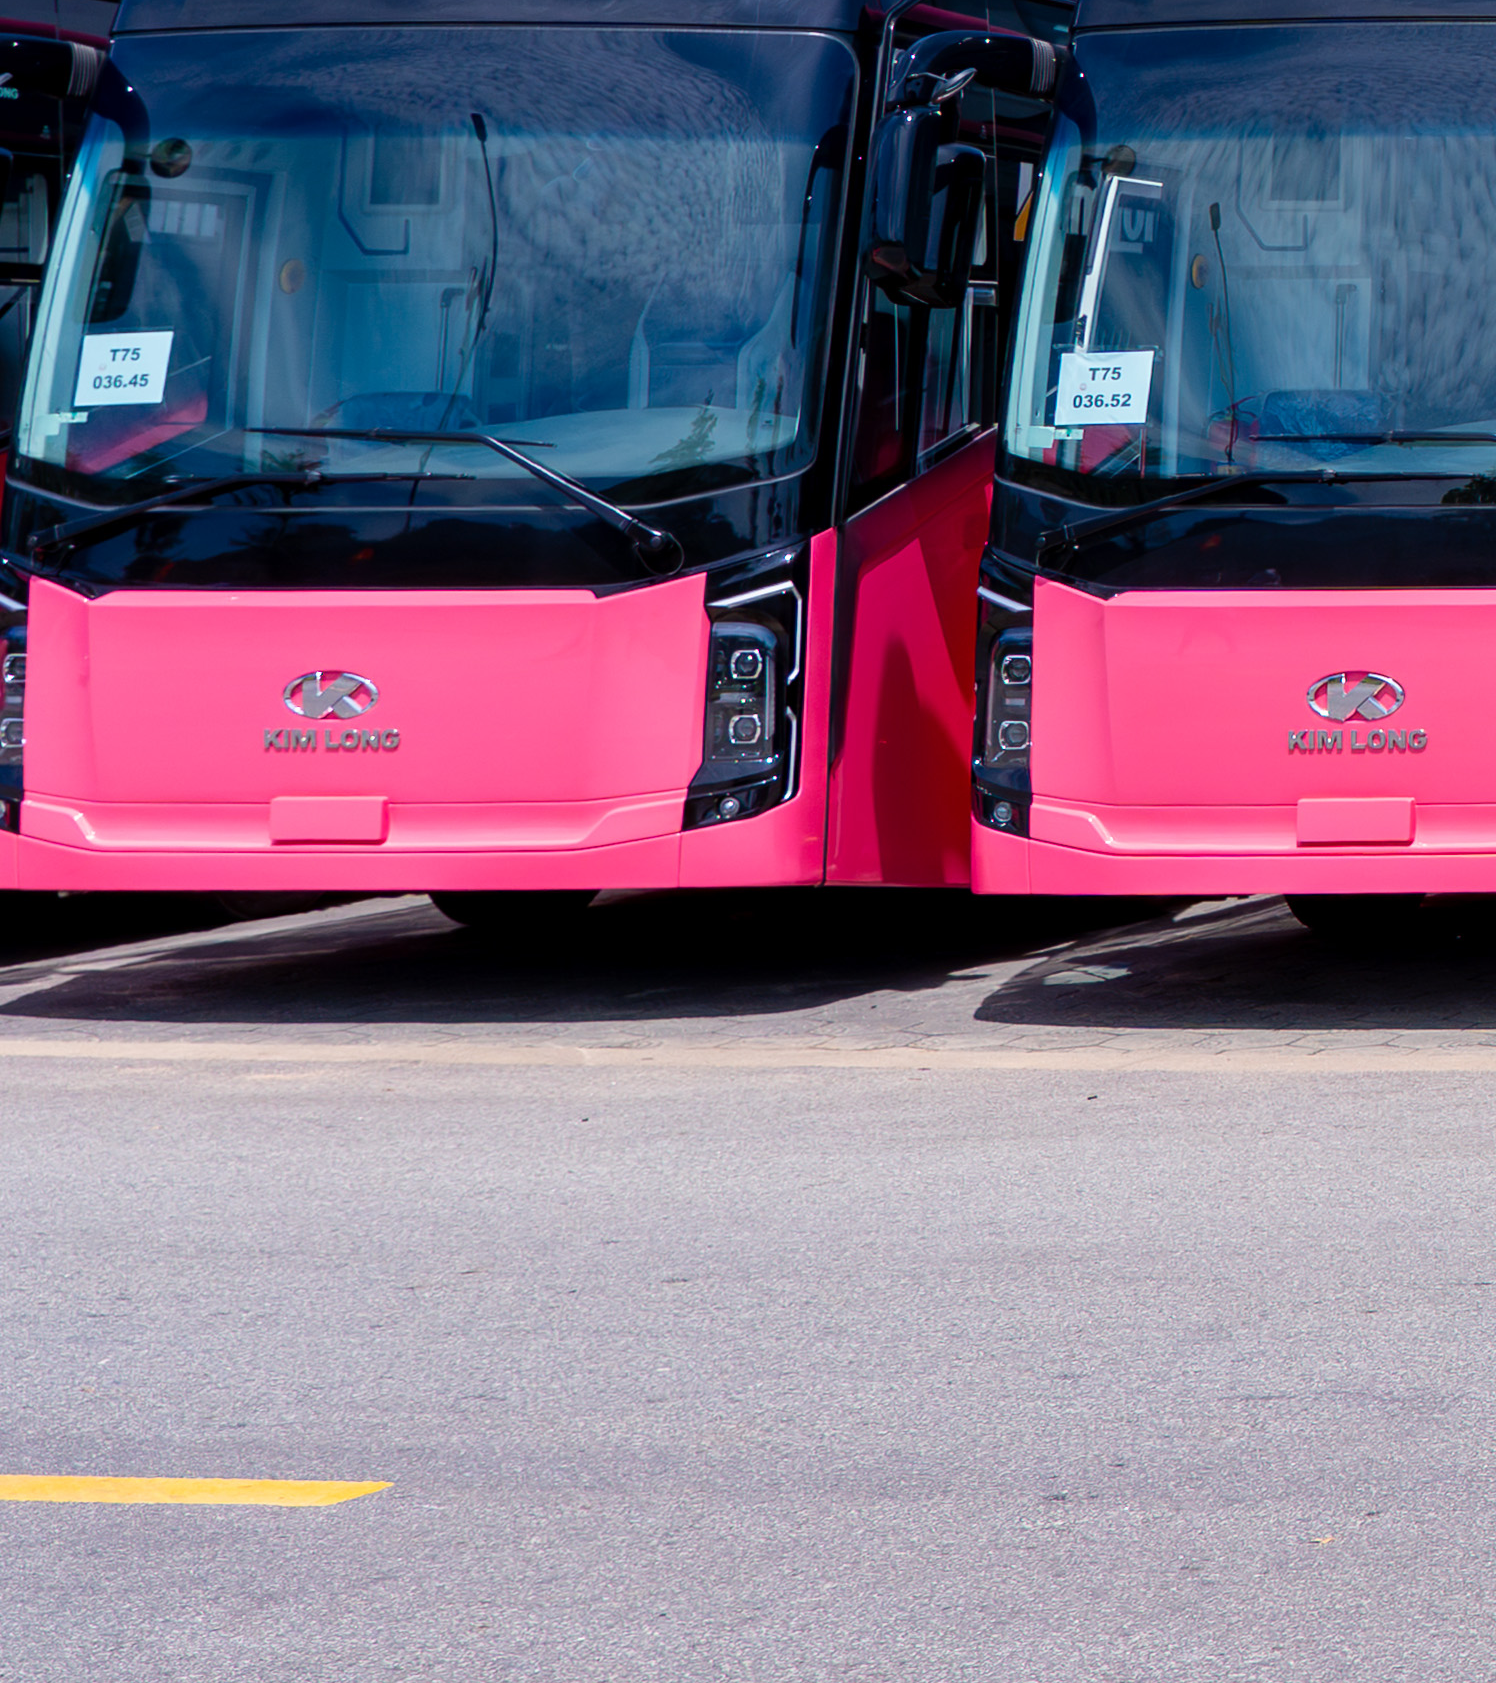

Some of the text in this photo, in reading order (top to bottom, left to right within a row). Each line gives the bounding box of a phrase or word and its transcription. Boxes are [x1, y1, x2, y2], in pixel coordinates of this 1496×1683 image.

[110, 347, 141, 362] T75
[93, 374, 150, 389] 036.45
[1089, 367, 1122, 381] T75
[1073, 394, 1132, 408] 036.52
[263, 728, 400, 750] KIM LONG
[1288, 729, 1428, 751] KIM LONG
